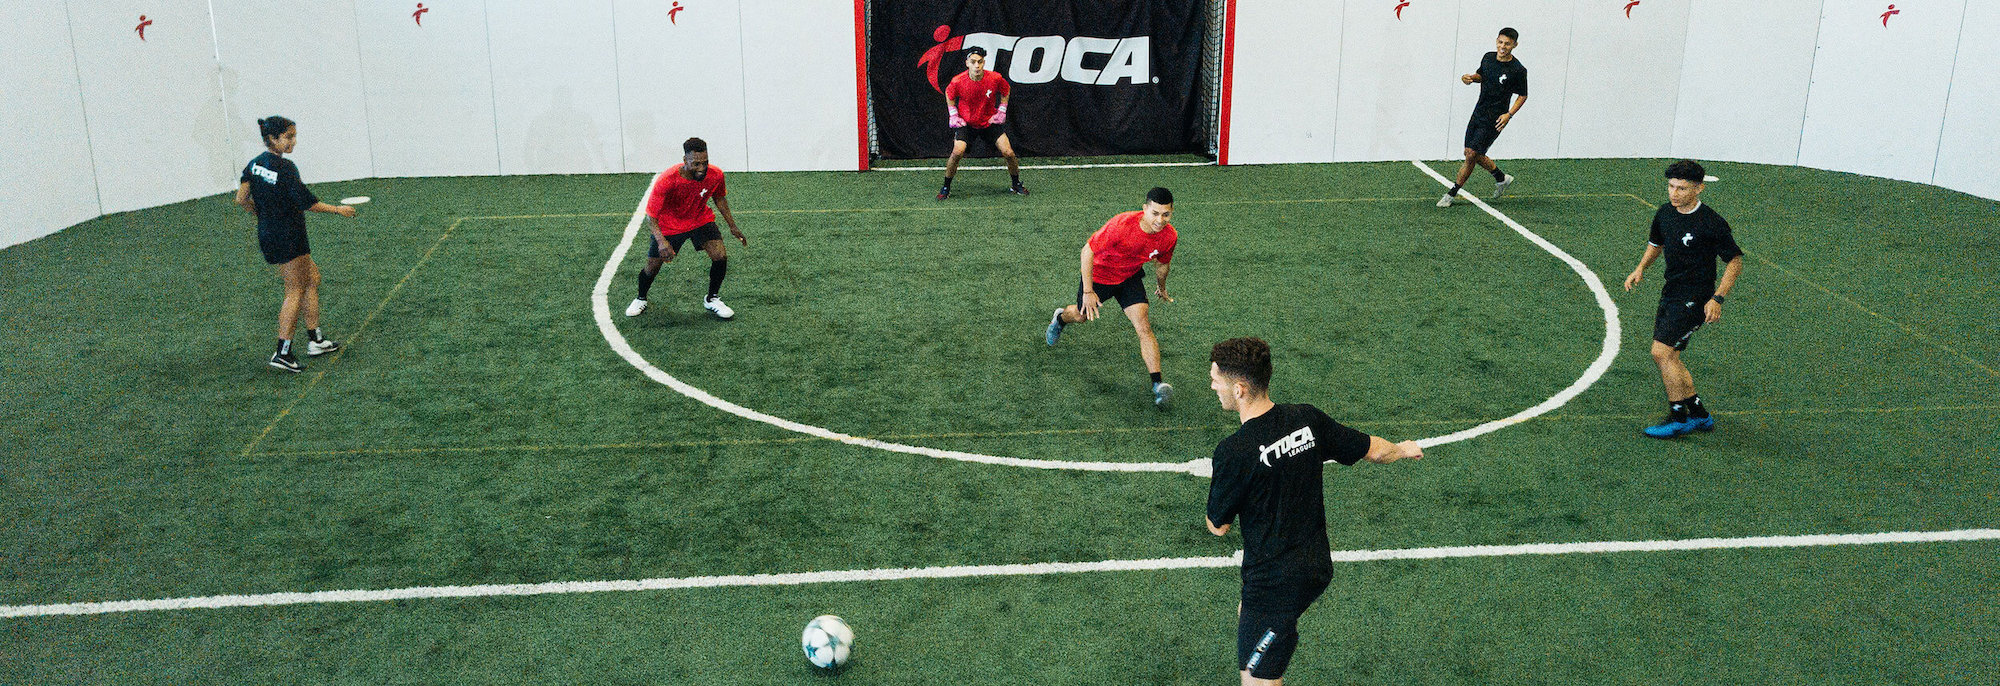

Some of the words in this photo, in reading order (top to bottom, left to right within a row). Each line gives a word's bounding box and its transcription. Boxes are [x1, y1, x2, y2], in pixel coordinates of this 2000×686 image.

[962, 32, 1150, 86] TOCA
[1269, 426, 1314, 459] TOCA
[1288, 441, 1316, 457] LEAGUES
